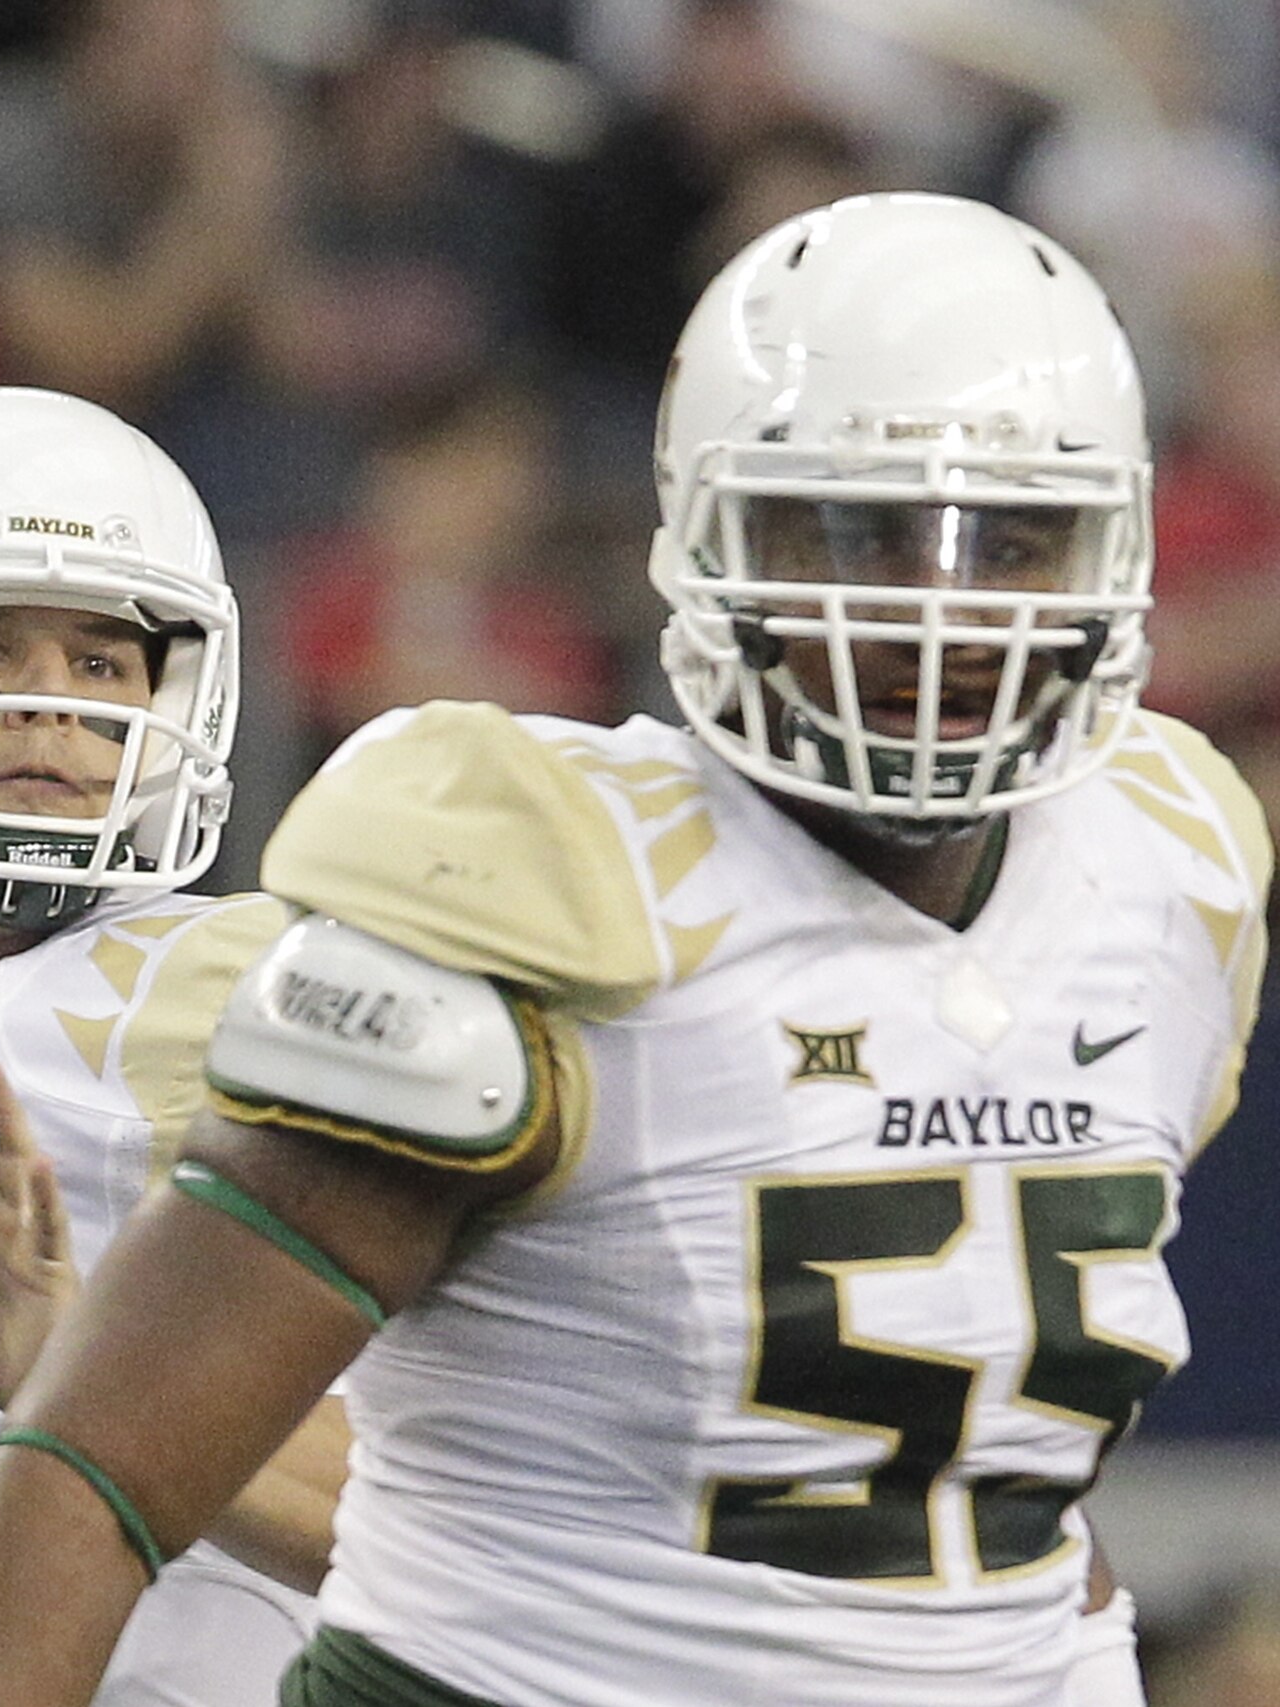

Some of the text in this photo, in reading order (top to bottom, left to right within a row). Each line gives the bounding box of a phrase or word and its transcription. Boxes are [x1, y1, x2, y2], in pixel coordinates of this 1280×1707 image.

[8, 516, 95, 541] BAYLOR
[876, 1098, 1104, 1148] BAYLOR
[692, 1160, 1182, 1590] 55
